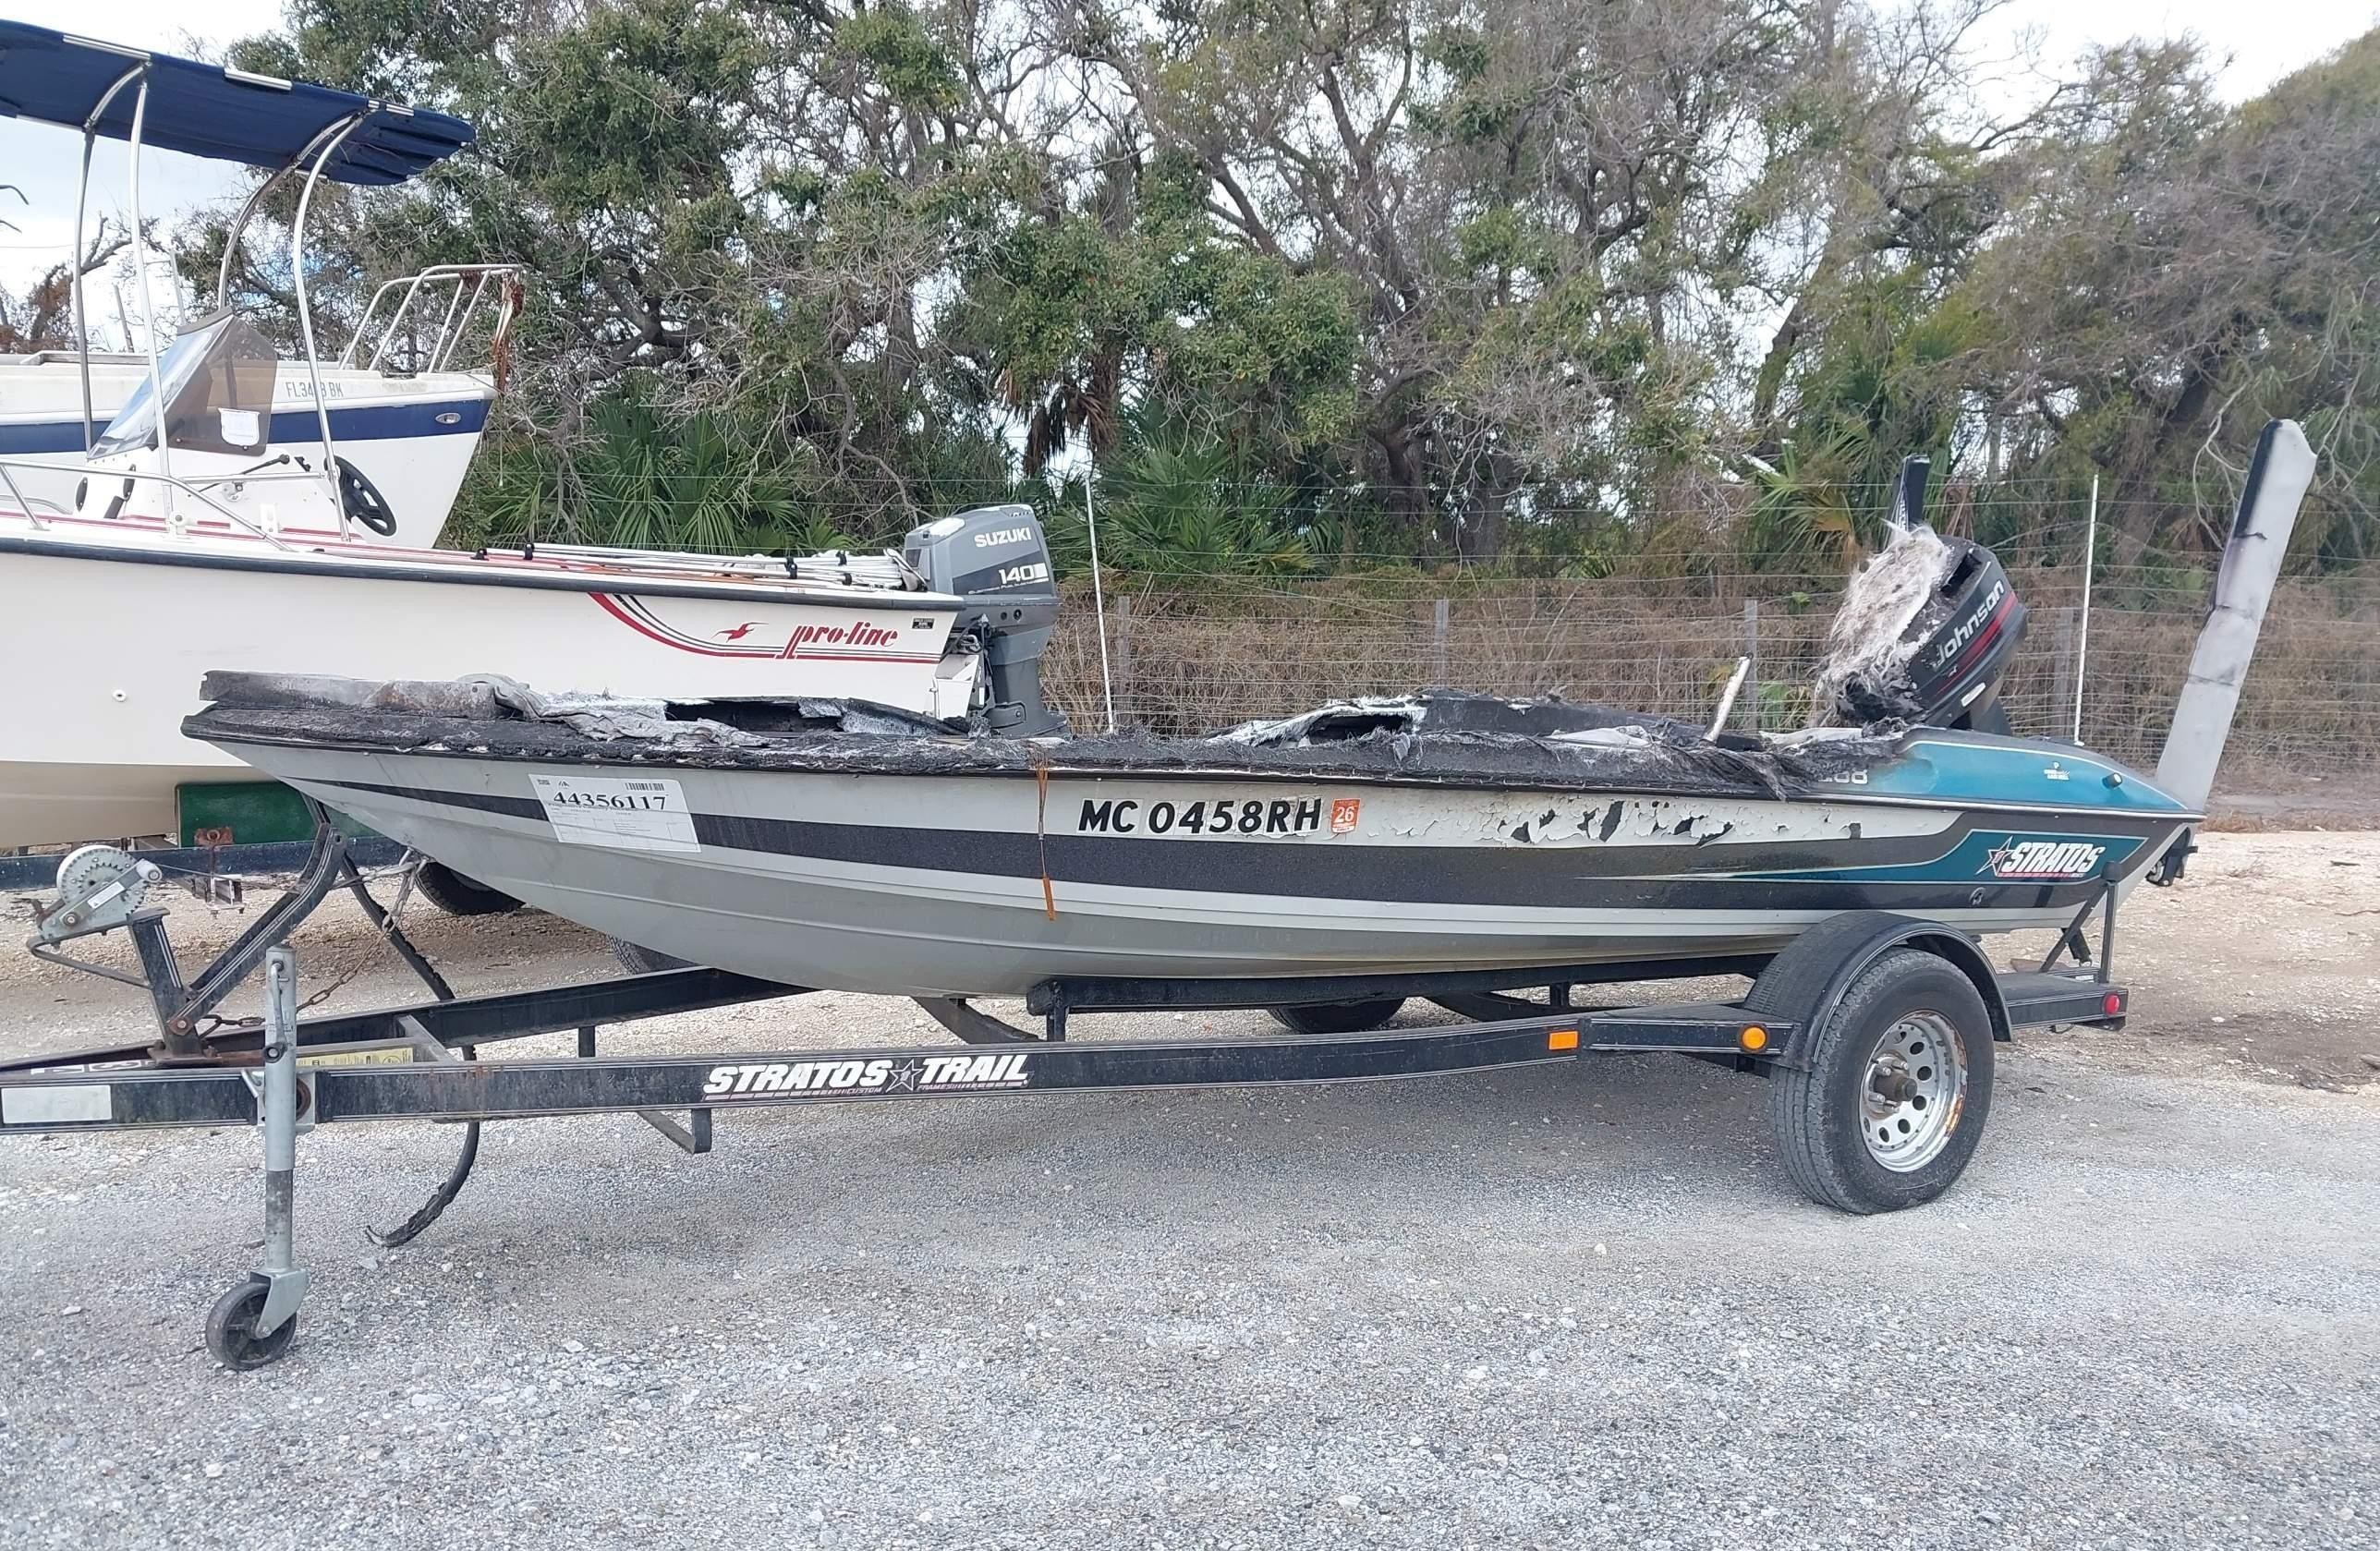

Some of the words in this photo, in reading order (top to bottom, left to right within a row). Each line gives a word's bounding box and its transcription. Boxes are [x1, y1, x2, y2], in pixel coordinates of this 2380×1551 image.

[974, 527, 1032, 548] SUZUKI
[999, 564, 1035, 585] 140
[1935, 580, 2005, 668] Johnson
[775, 622, 898, 660] pro-line
[553, 792, 667, 810] 44356117
[1078, 799, 1138, 831] MC
[1148, 797, 1322, 834] 0458RH
[1334, 806, 1355, 823] 26
[2000, 842, 2107, 873] STRATOS
[703, 1060, 892, 1094] STRATOS
[918, 1055, 1029, 1084] TRAIL
